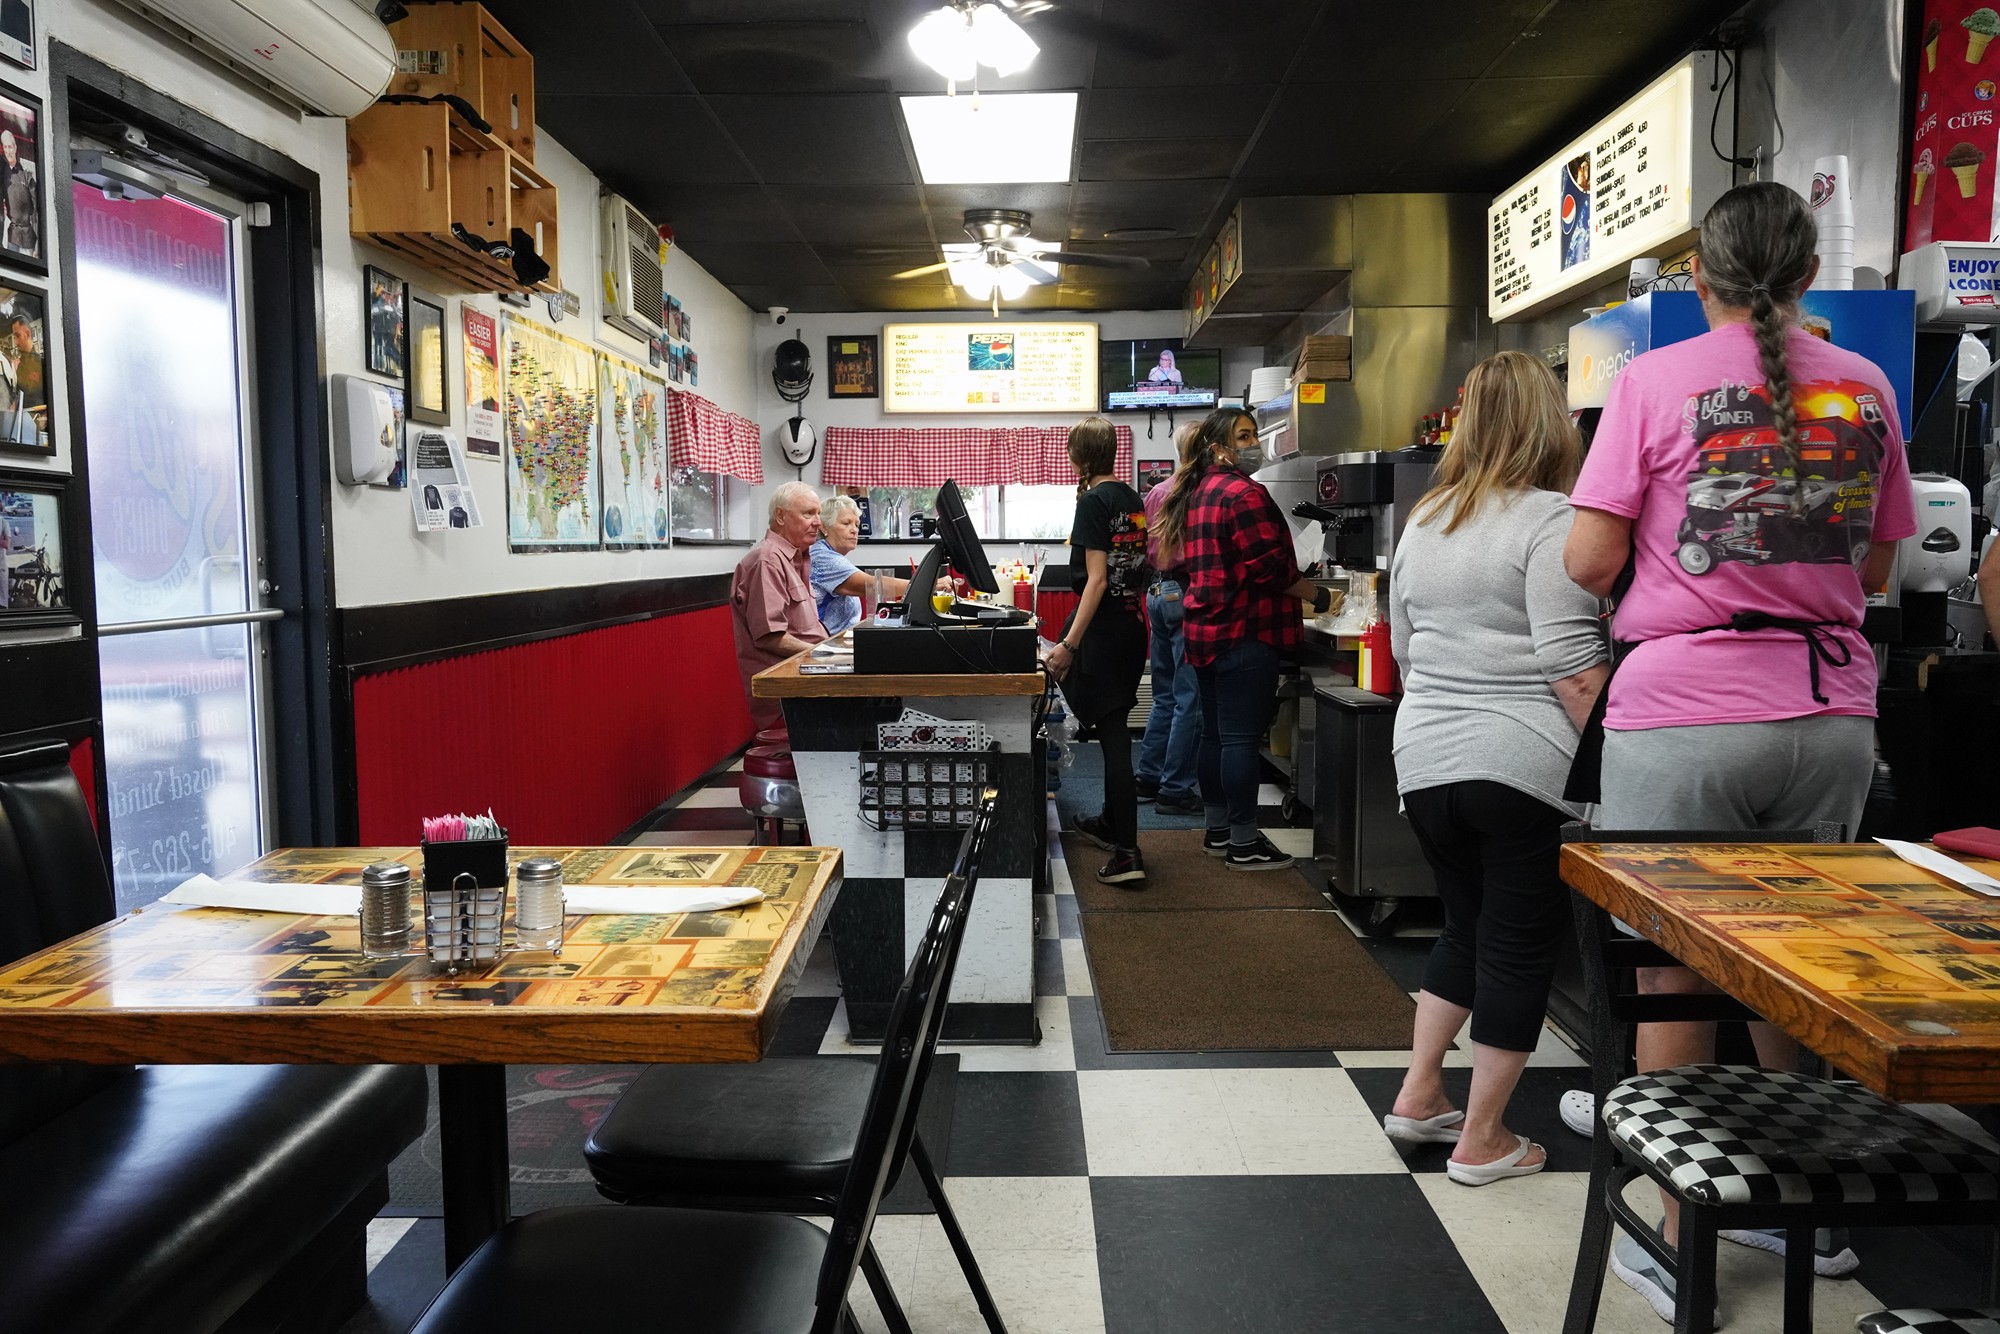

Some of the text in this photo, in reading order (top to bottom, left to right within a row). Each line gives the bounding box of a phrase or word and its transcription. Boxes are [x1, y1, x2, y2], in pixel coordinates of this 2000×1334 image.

[1972, 109, 1993, 117] CREAM
[1915, 116, 1937, 141] CUPS
[1947, 114, 1993, 130] CUPS
[1597, 139, 1610, 156] MALTS
[1617, 122, 1634, 141] SHAKES
[1597, 153, 1612, 171] FLOATS
[1595, 197, 1610, 213] CONES
[1634, 196, 1643, 209] FOR
[1653, 196, 1664, 212] ONLY
[1949, 259, 2000, 277] ENJOY
[1957, 278, 2000, 291] CONE
[551, 295, 563, 320] 66
[469, 321, 492, 342] EASIER
[971, 334, 1014, 344] PEPSI
[1597, 340, 1635, 389] pepsi
[1681, 378, 1756, 436] Sid's
[1864, 404, 1882, 421] 66
[1713, 410, 1754, 426] DINER
[1833, 498, 1847, 513] of
